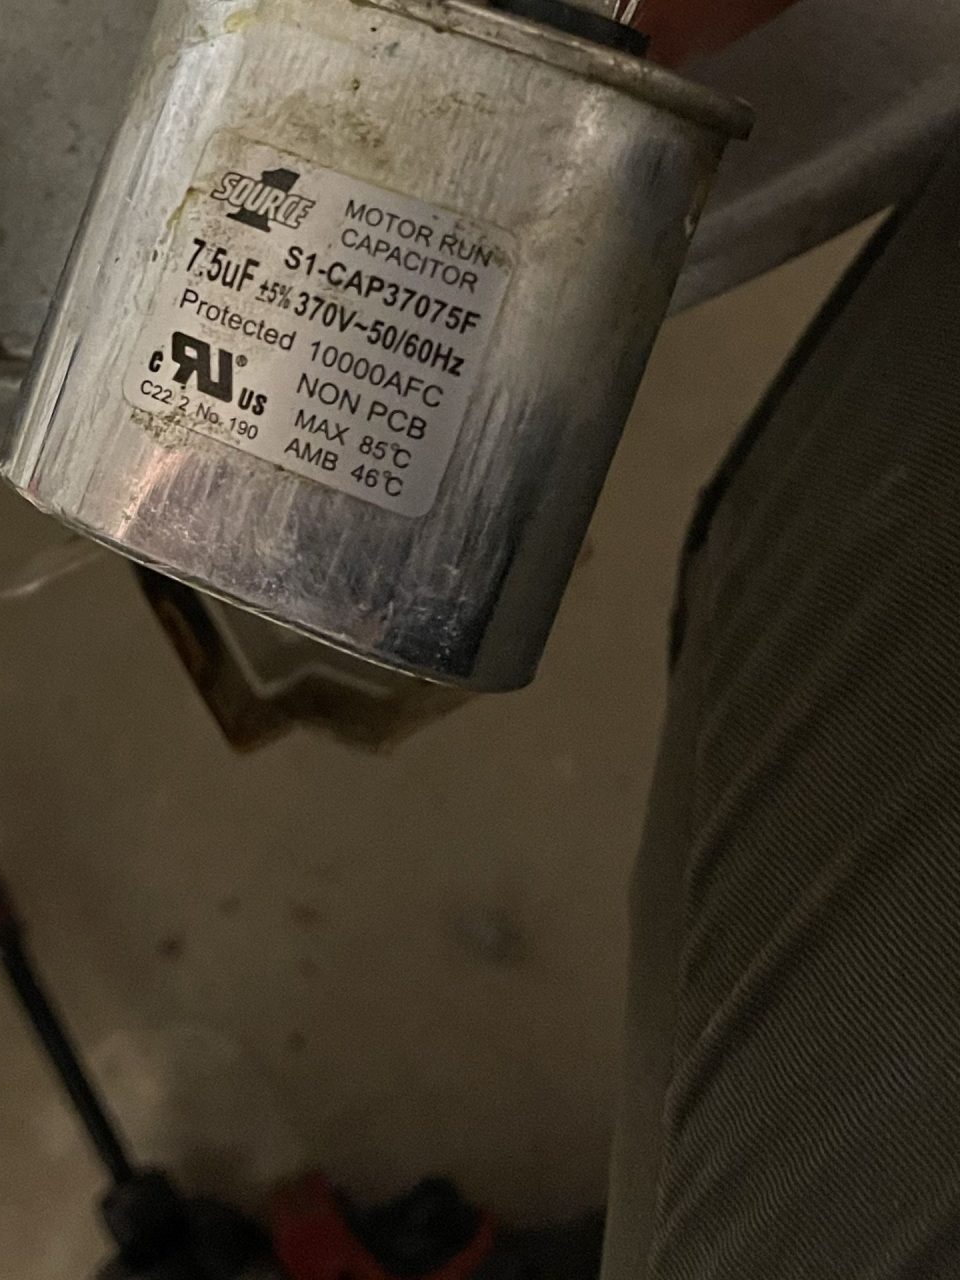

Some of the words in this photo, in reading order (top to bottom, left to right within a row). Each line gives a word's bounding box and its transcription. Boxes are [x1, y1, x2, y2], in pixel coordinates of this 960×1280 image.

[209, 171, 317, 230] SOURCE
[186, 237, 261, 292] 7.5uF
[340, 227, 479, 294] CAPACITOR
[344, 198, 434, 248] MOTOR
[439, 233, 493, 268] RUN
[284, 245, 482, 335] S1-CAP37075F
[179, 287, 297, 352] Protected
[310, 340, 445, 408] 10000AFC
[229, 417, 259, 440] 190
[294, 408, 351, 446] MAX
[296, 372, 362, 415] NON
[366, 400, 428, 440] PCB
[283, 437, 339, 472] AMB
